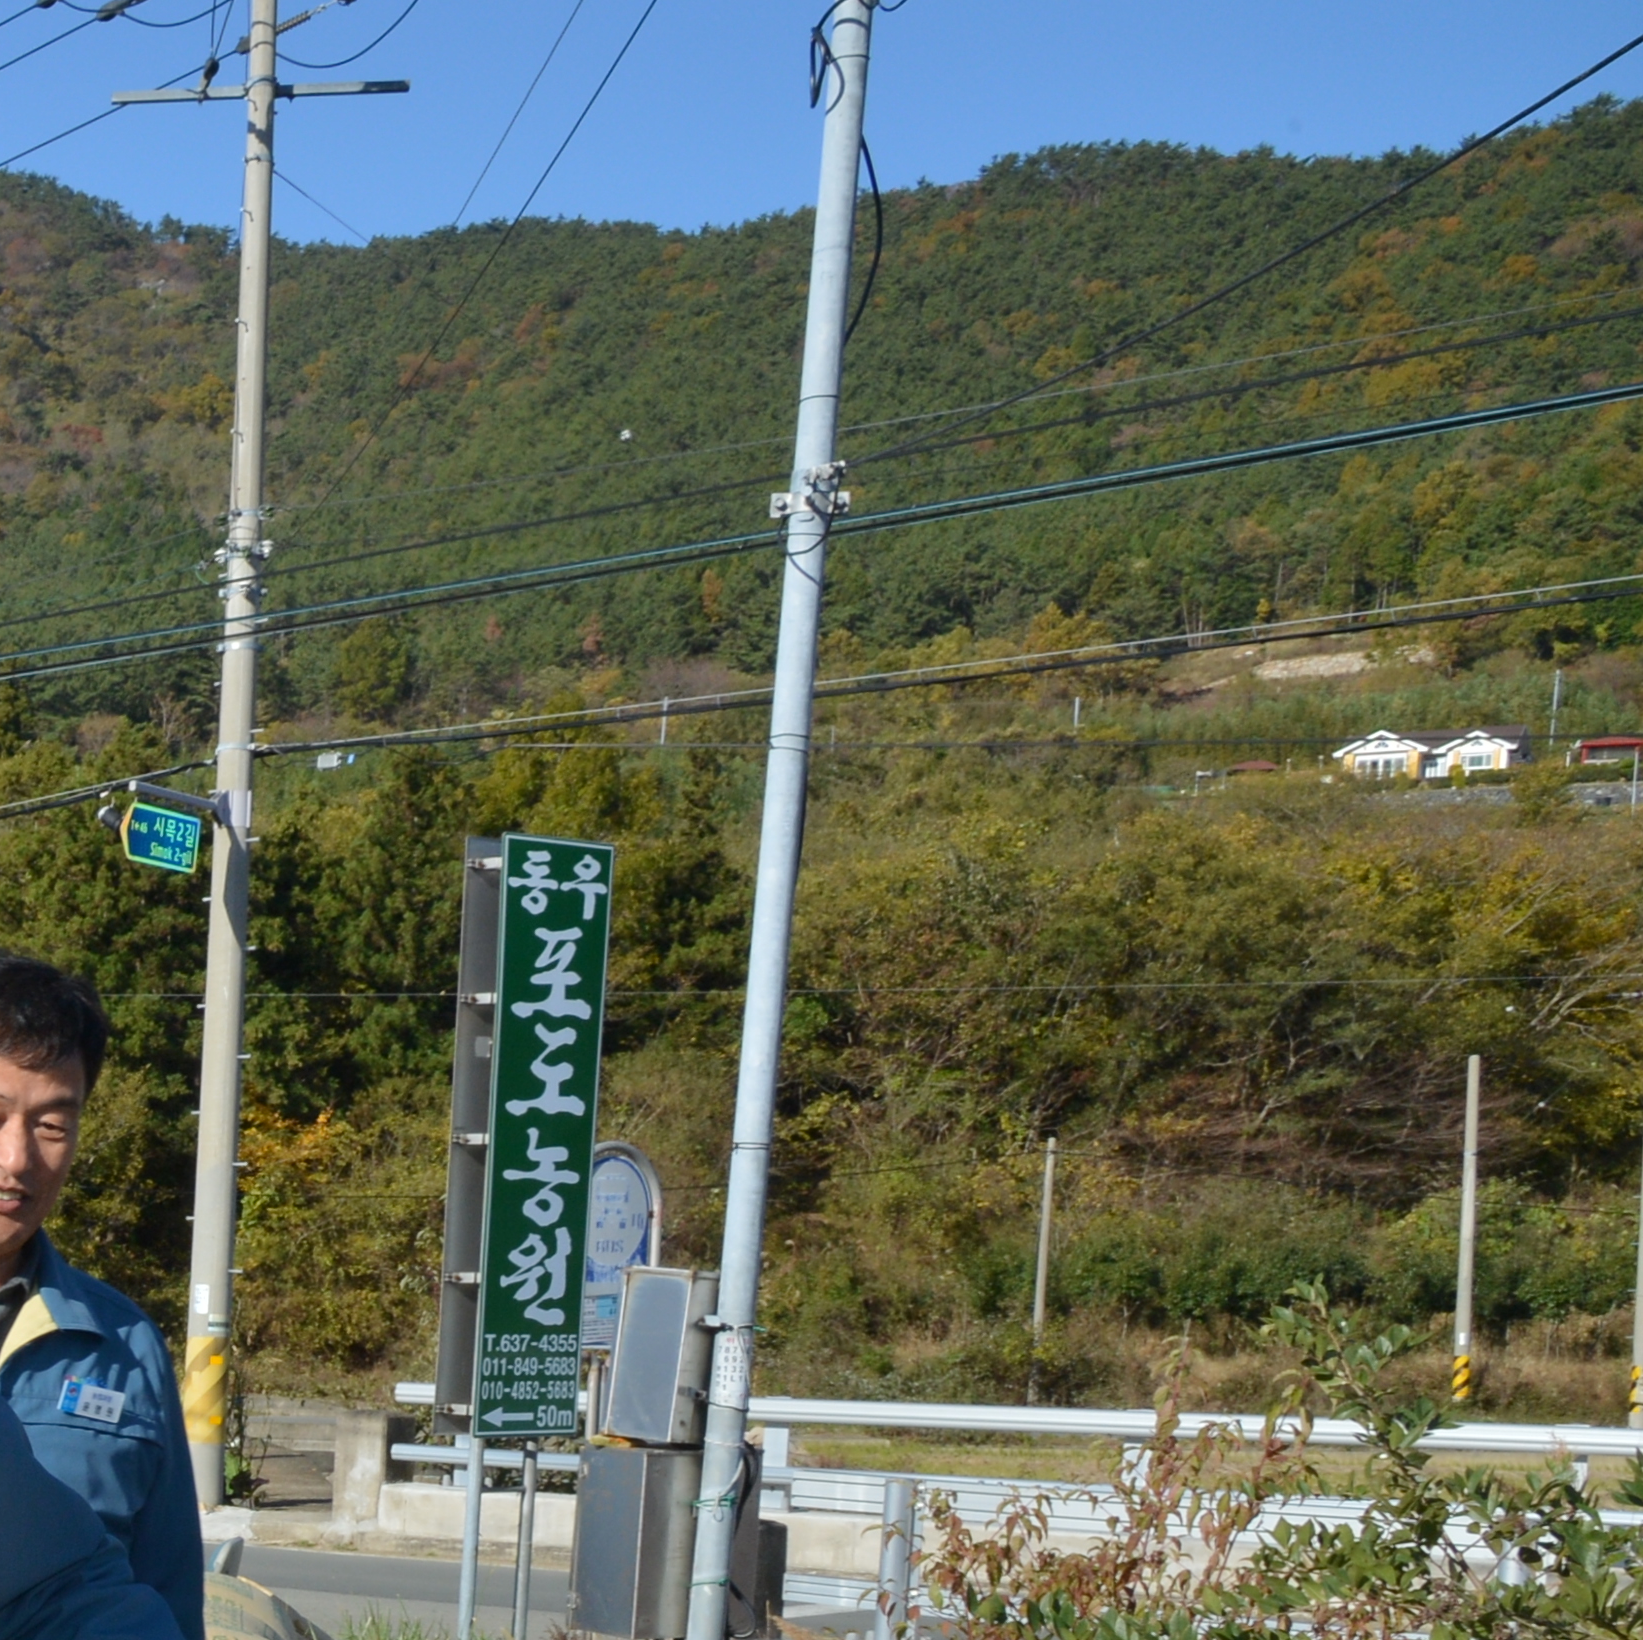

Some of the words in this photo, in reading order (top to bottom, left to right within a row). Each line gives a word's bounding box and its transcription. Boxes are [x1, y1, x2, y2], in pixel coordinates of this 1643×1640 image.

[154, 816, 195, 848] 시목2길
[499, 927, 592, 1326] 포도농원
[484, 1334, 578, 1352] T.637-4355
[482, 1357, 576, 1377] 011-849-5683
[536, 1406, 573, 1428] 50m
